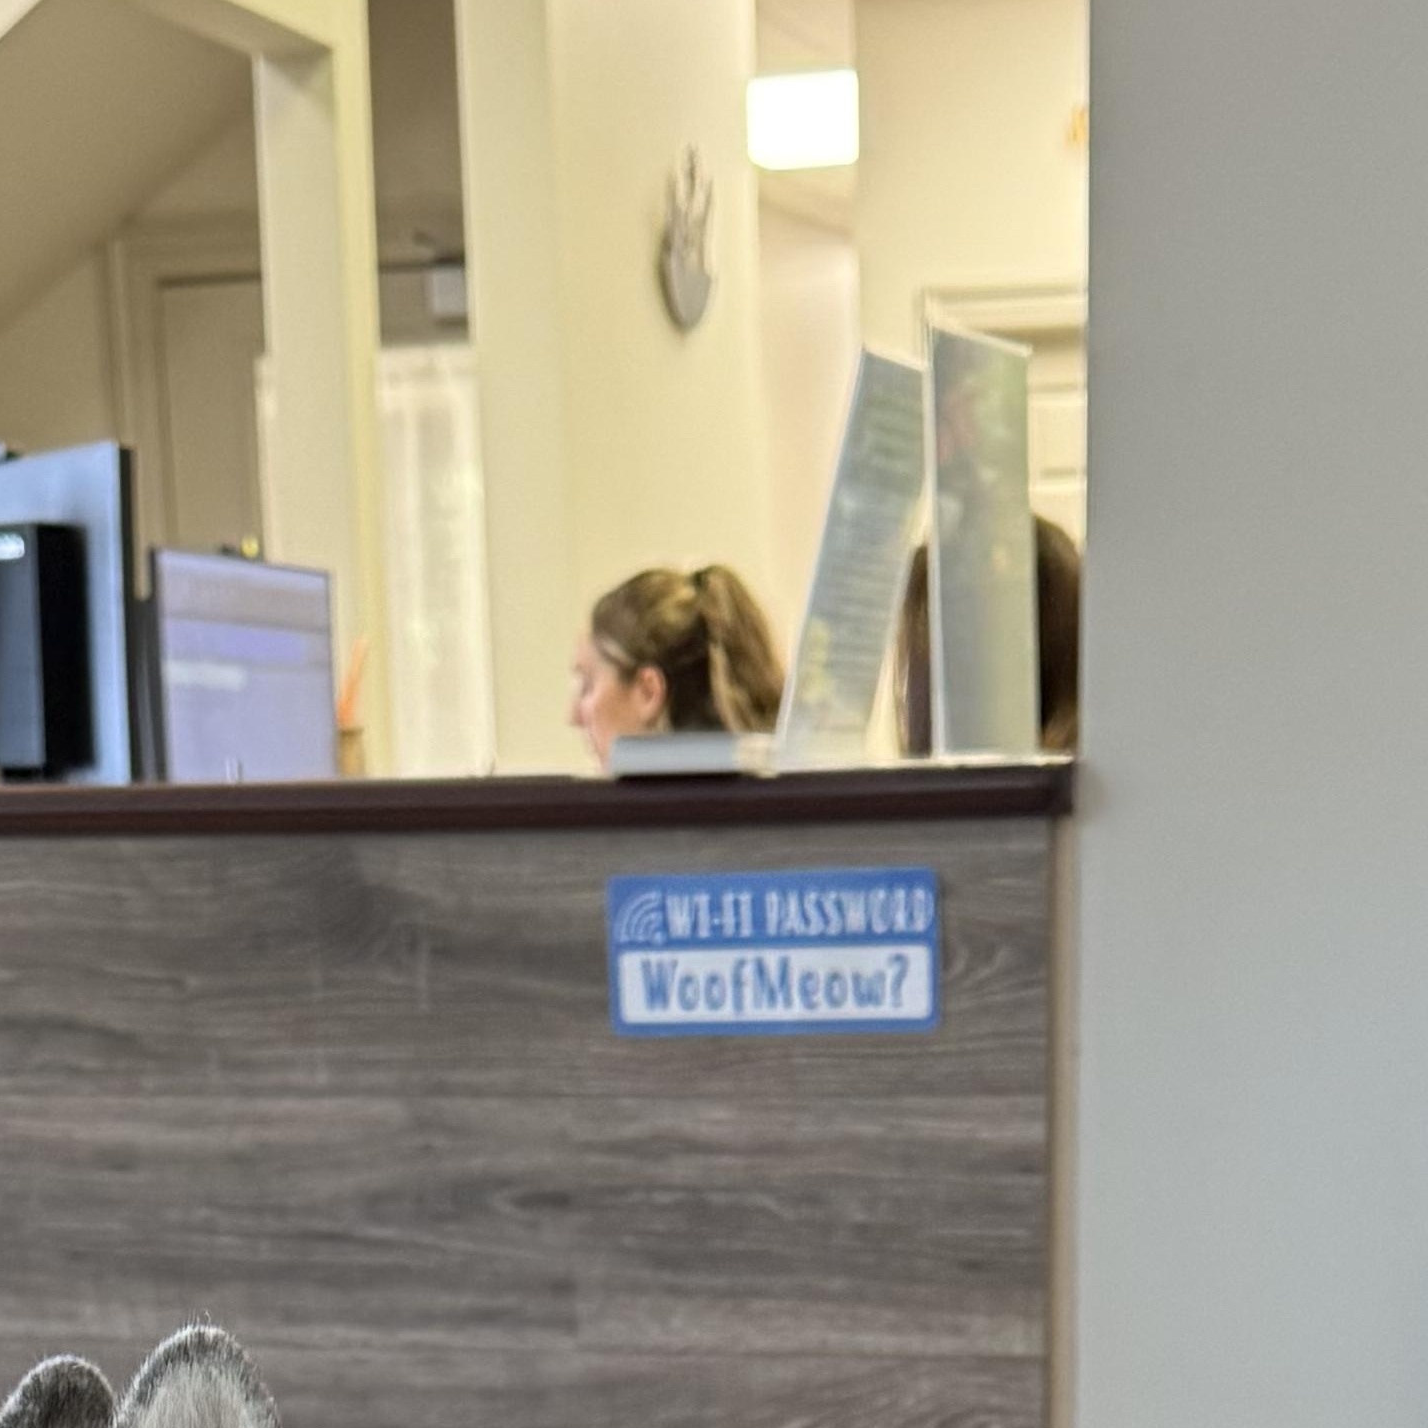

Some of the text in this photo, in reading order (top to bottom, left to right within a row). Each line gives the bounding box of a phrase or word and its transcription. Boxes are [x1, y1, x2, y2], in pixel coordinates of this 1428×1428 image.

[665, 888, 934, 939] WI-FI PASSWORD
[641, 953, 910, 1014] WoofMeow?
